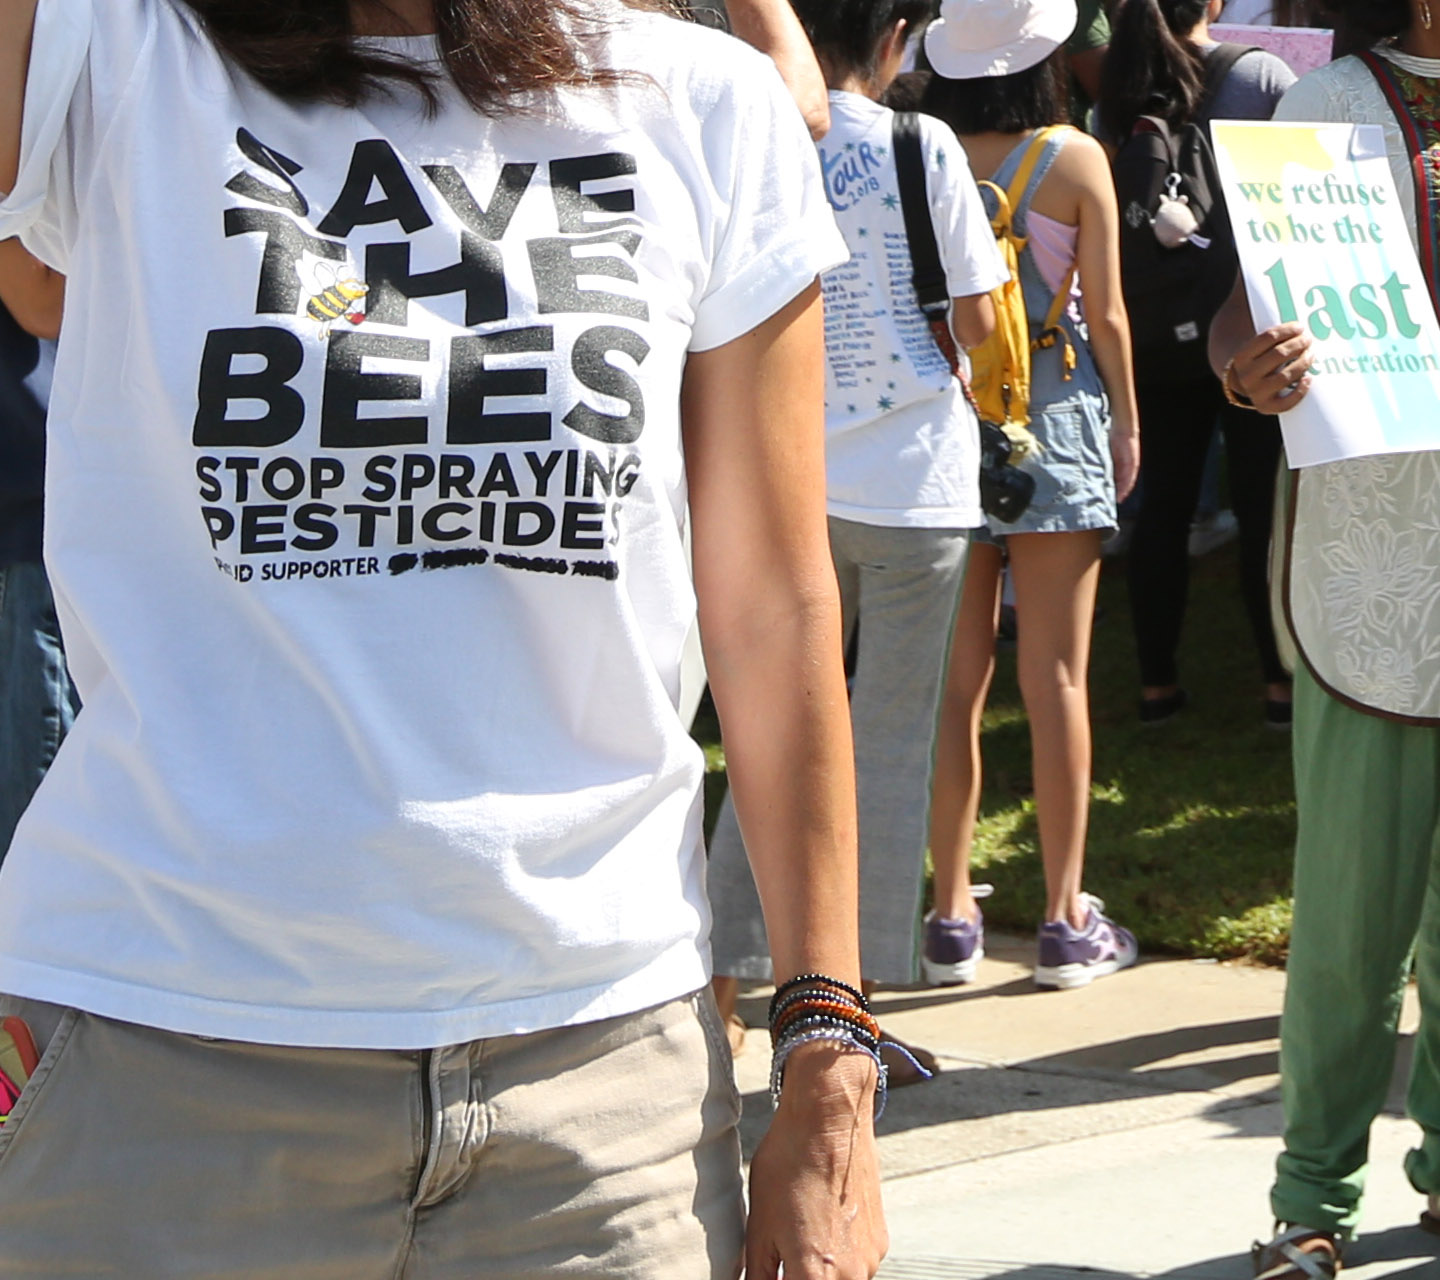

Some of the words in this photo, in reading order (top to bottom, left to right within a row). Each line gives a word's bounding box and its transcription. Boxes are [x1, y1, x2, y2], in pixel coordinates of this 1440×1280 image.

[224, 127, 643, 239] SAVE
[847, 177, 880, 205] 2018
[1236, 182, 1282, 205] we
[1291, 173, 1386, 206] refuse
[1247, 218, 1281, 243] to
[1286, 214, 1326, 244] be
[1333, 214, 1384, 244] the
[224, 207, 650, 326] THE
[1264, 257, 1421, 340] last
[1310, 345, 1439, 376] eneration
[193, 325, 651, 447] BEES
[196, 456, 345, 503] STOP
[361, 450, 641, 502] SPRAYING
[262, 557, 380, 580] SUPPORTER
